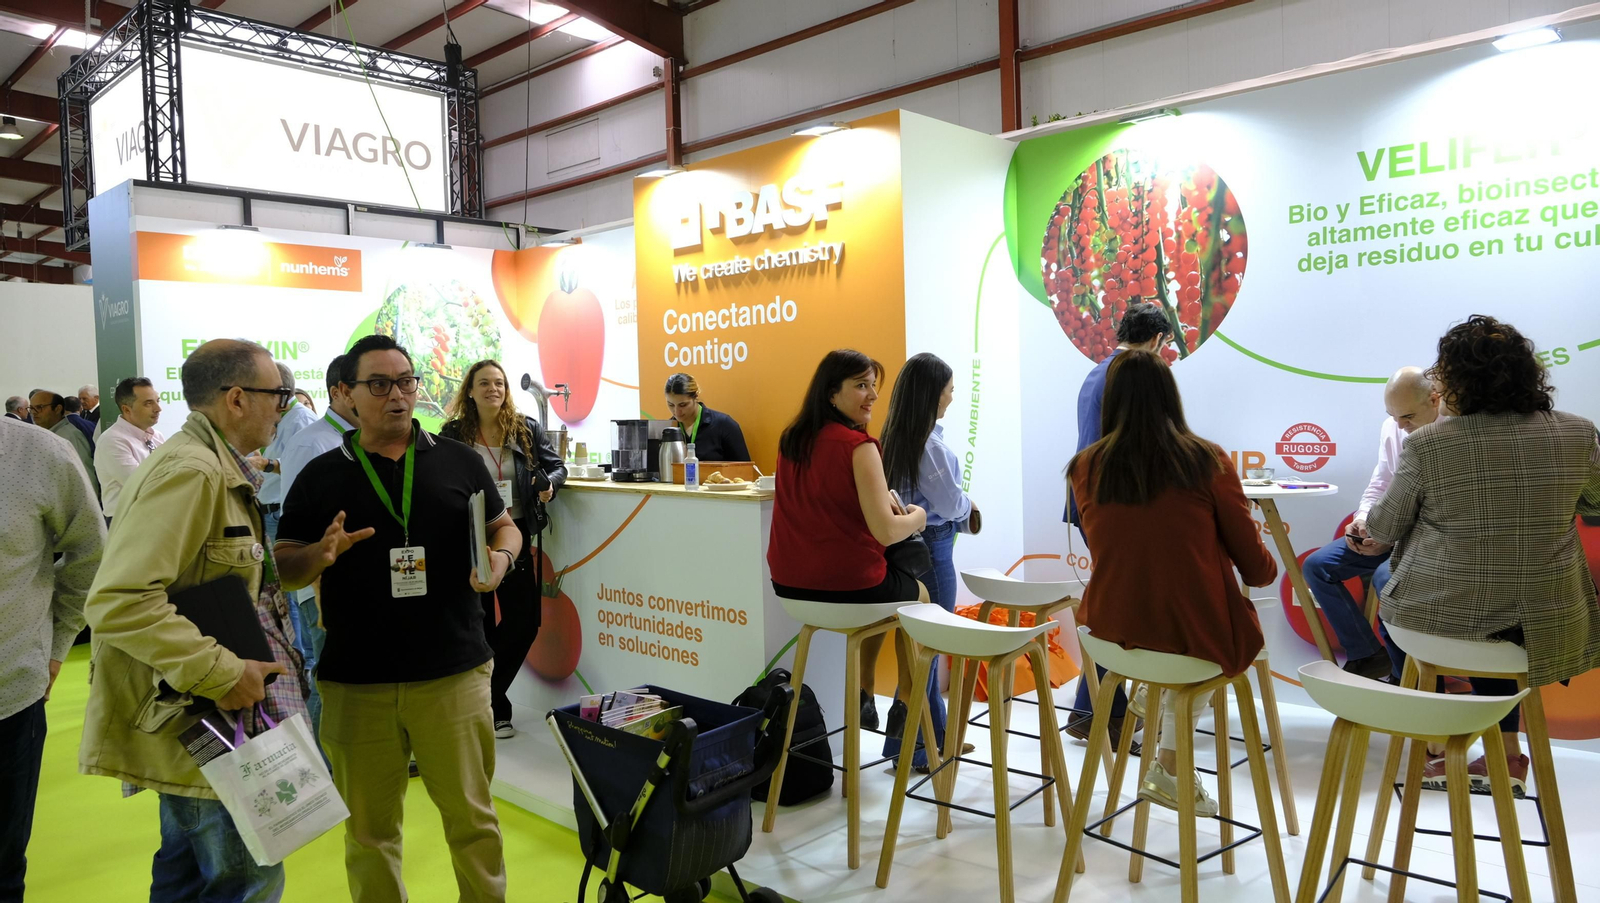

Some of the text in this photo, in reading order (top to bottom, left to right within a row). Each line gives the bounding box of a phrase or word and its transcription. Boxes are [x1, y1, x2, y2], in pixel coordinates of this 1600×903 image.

[116, 111, 166, 165] VIAGO
[280, 118, 432, 171] VIAGRO
[1357, 128, 1563, 182] VELIF
[726, 170, 844, 239] BASF
[1289, 202, 1328, 224] Bio
[1336, 202, 1351, 223] y
[1359, 191, 1448, 216] Eficaz,
[1307, 199, 1599, 247] altamente eficaz que
[281, 261, 348, 277] nunhems
[672, 240, 845, 284] We create chemistry
[1297, 250, 1348, 275] deja
[1357, 241, 1460, 267] residuo
[1468, 238, 1503, 257] en
[1514, 232, 1543, 253] tu
[108, 300, 129, 318] VIAGRO
[663, 295, 798, 335] Conectando
[663, 337, 748, 370] Contigo
[293, 368, 324, 380] está
[960, 358, 981, 494] EDIO AMBIENTE
[1284, 424, 1326, 440] RESISTENCIA
[1282, 444, 1329, 454] RUGOSO
[597, 583, 748, 626] Juntos convertimos
[597, 609, 703, 643] oportunidades
[598, 631, 699, 667] en soluciones
[239, 742, 297, 782] Farmacia
